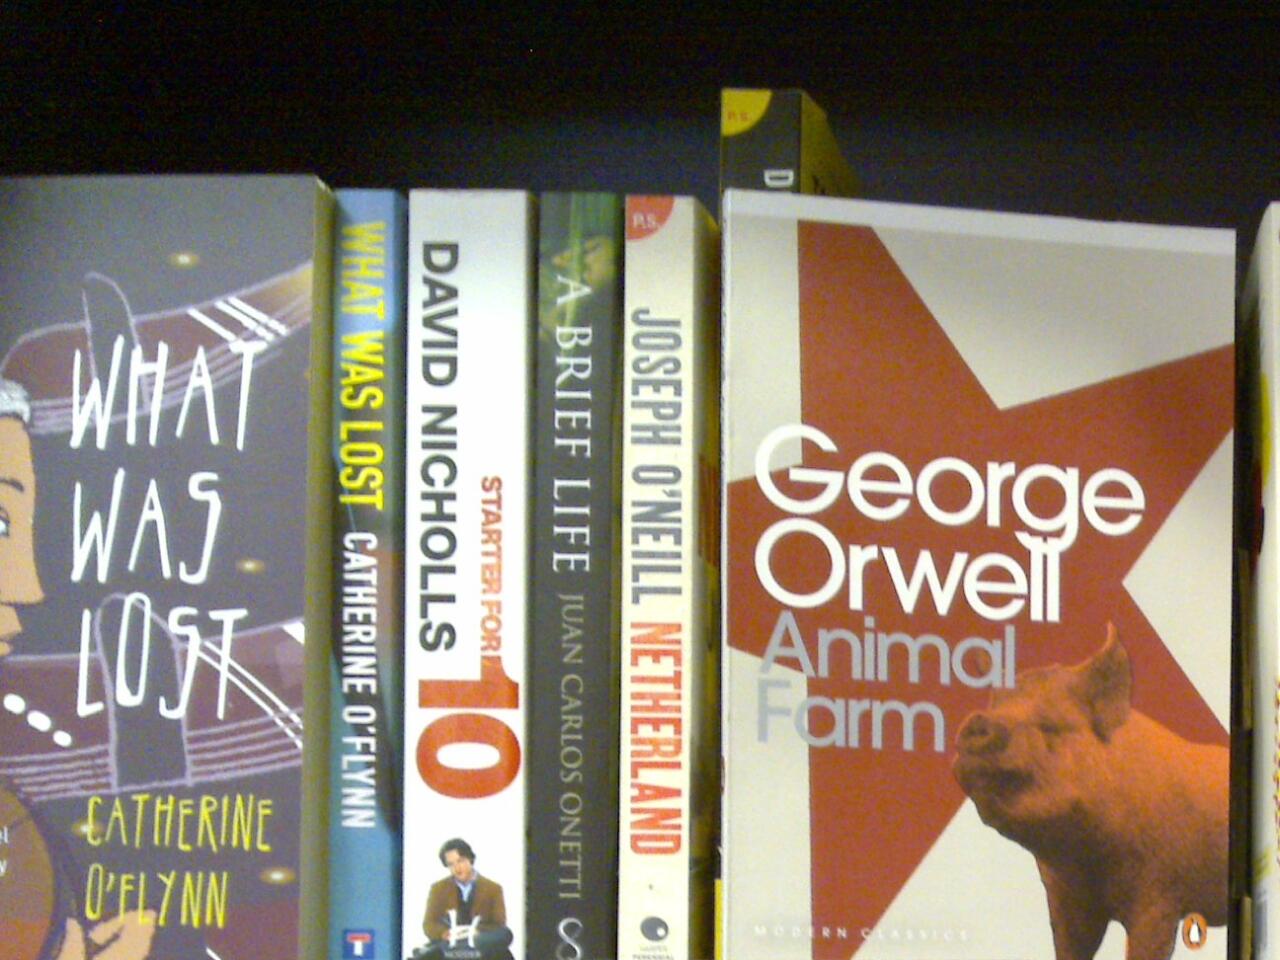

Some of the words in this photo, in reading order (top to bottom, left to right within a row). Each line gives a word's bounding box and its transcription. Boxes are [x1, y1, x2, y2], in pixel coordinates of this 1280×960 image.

[341, 220, 386, 319] WHAT
[421, 241, 460, 387] DAVID
[554, 275, 592, 305] A
[70, 335, 268, 450] WHAT
[340, 330, 386, 410] WAS
[554, 325, 593, 458] BRIEF
[630, 307, 682, 446] JOSEPH
[340, 421, 384, 511] LOST
[754, 424, 1146, 554] George
[70, 467, 222, 584] WAS
[418, 404, 459, 652] NICHOLLS
[480, 475, 503, 594] STARTER
[552, 478, 591, 573] LIFE
[630, 464, 682, 605] O'NEILL
[754, 518, 1061, 622] Orwell
[77, 592, 249, 719] LOST
[342, 532, 378, 695] CATHERINE
[480, 600, 503, 652] FOR
[558, 594, 585, 664] JUAN
[759, 610, 1016, 688] Animal
[341, 707, 376, 829] O'FLYNN
[416, 655, 522, 799] 10
[558, 674, 584, 785] CARLOS
[630, 622, 682, 855] NETHERLAND
[757, 679, 945, 752] Farm
[86, 794, 273, 853] CATHERINE
[558, 792, 583, 899] ONETTI
[85, 863, 228, 929] O'FLYNN
